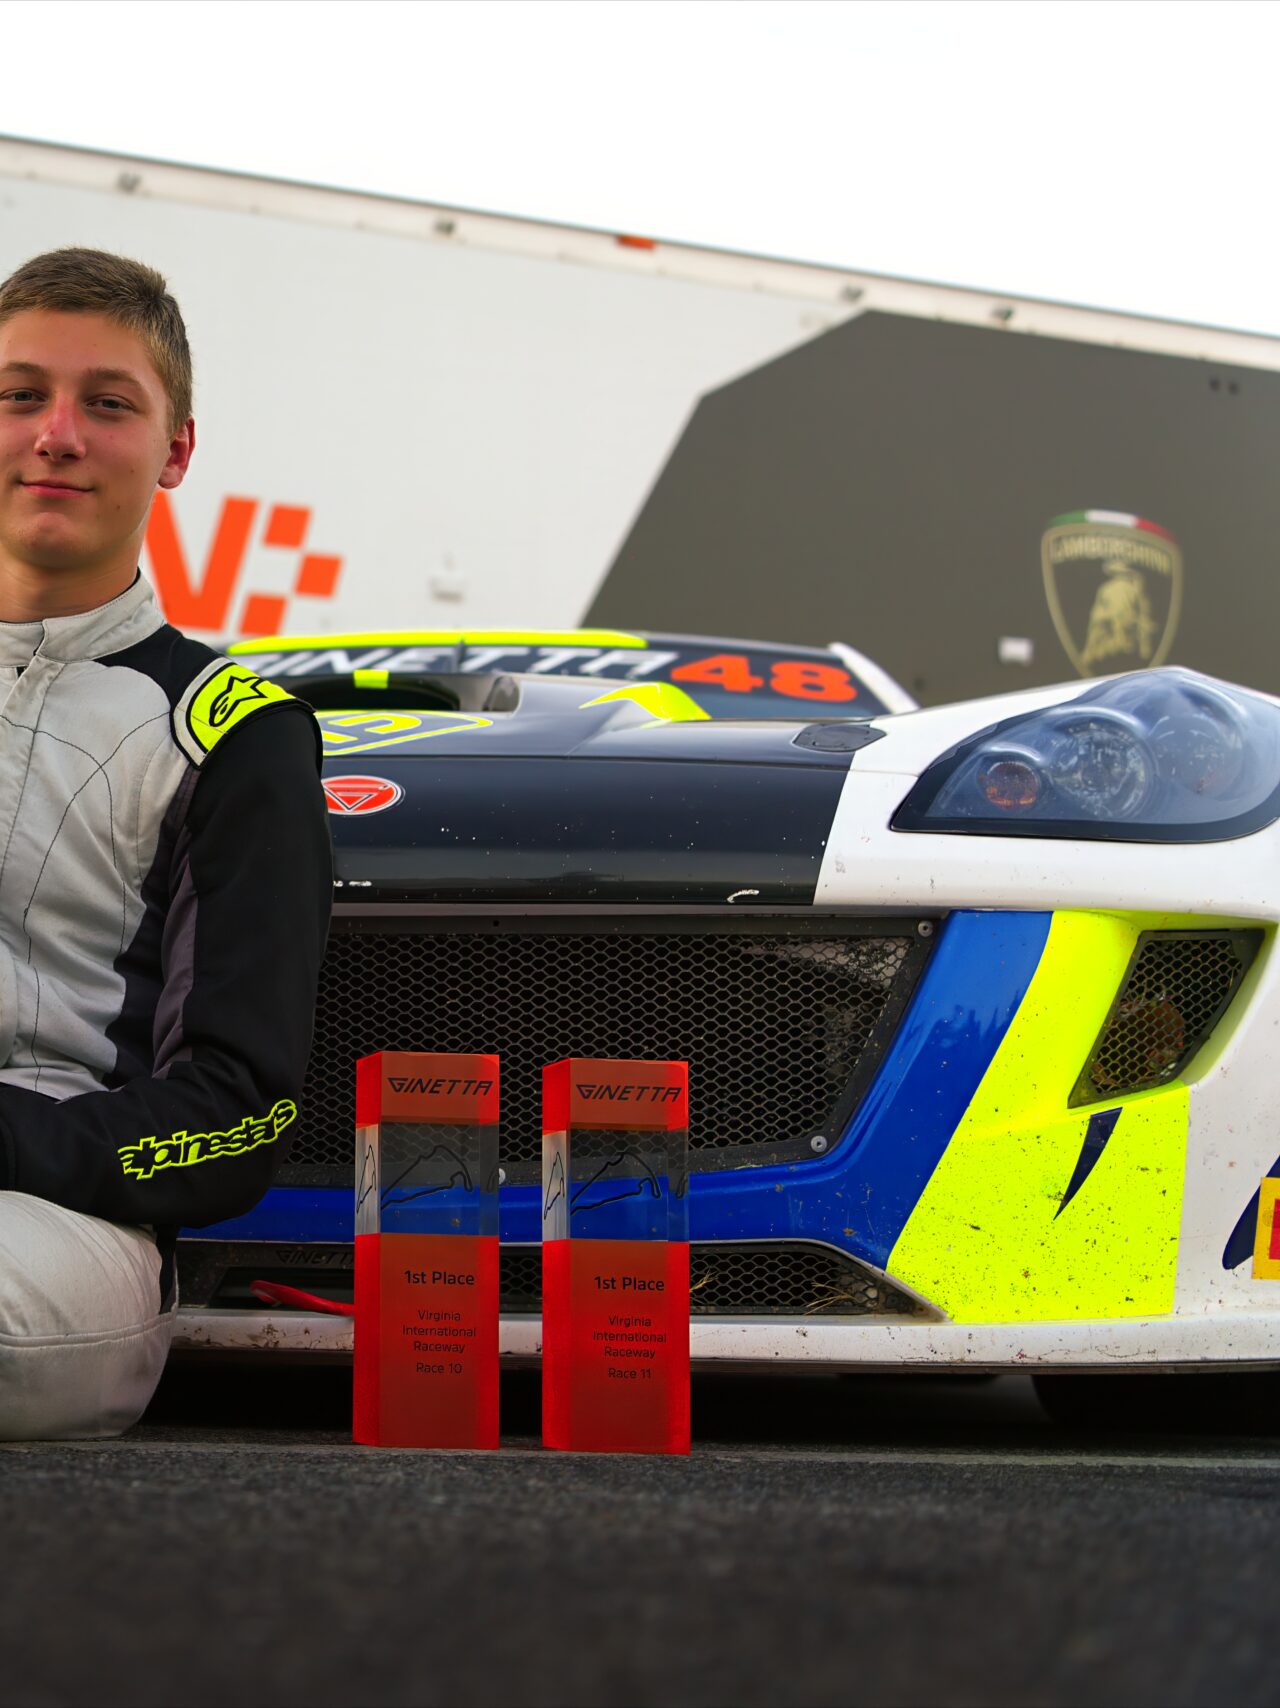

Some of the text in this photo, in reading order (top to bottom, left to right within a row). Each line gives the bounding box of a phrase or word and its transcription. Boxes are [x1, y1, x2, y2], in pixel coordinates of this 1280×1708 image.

[671, 654, 857, 703] 48
[387, 1077, 494, 1096] GINETTA
[576, 1084, 682, 1102] GINETTA
[276, 1249, 355, 1265] GINETT
[404, 1270, 475, 1285] 1st Place
[594, 1276, 665, 1291] 1st Place
[417, 1310, 461, 1322] Virginia
[608, 1316, 652, 1328] Virginia
[402, 1325, 476, 1337] International
[593, 1331, 667, 1343] International
[413, 1341, 465, 1354] Raceway
[604, 1347, 655, 1360] Raceway
[416, 1362, 463, 1374] Race 10
[608, 1368, 652, 1379] Race 11
